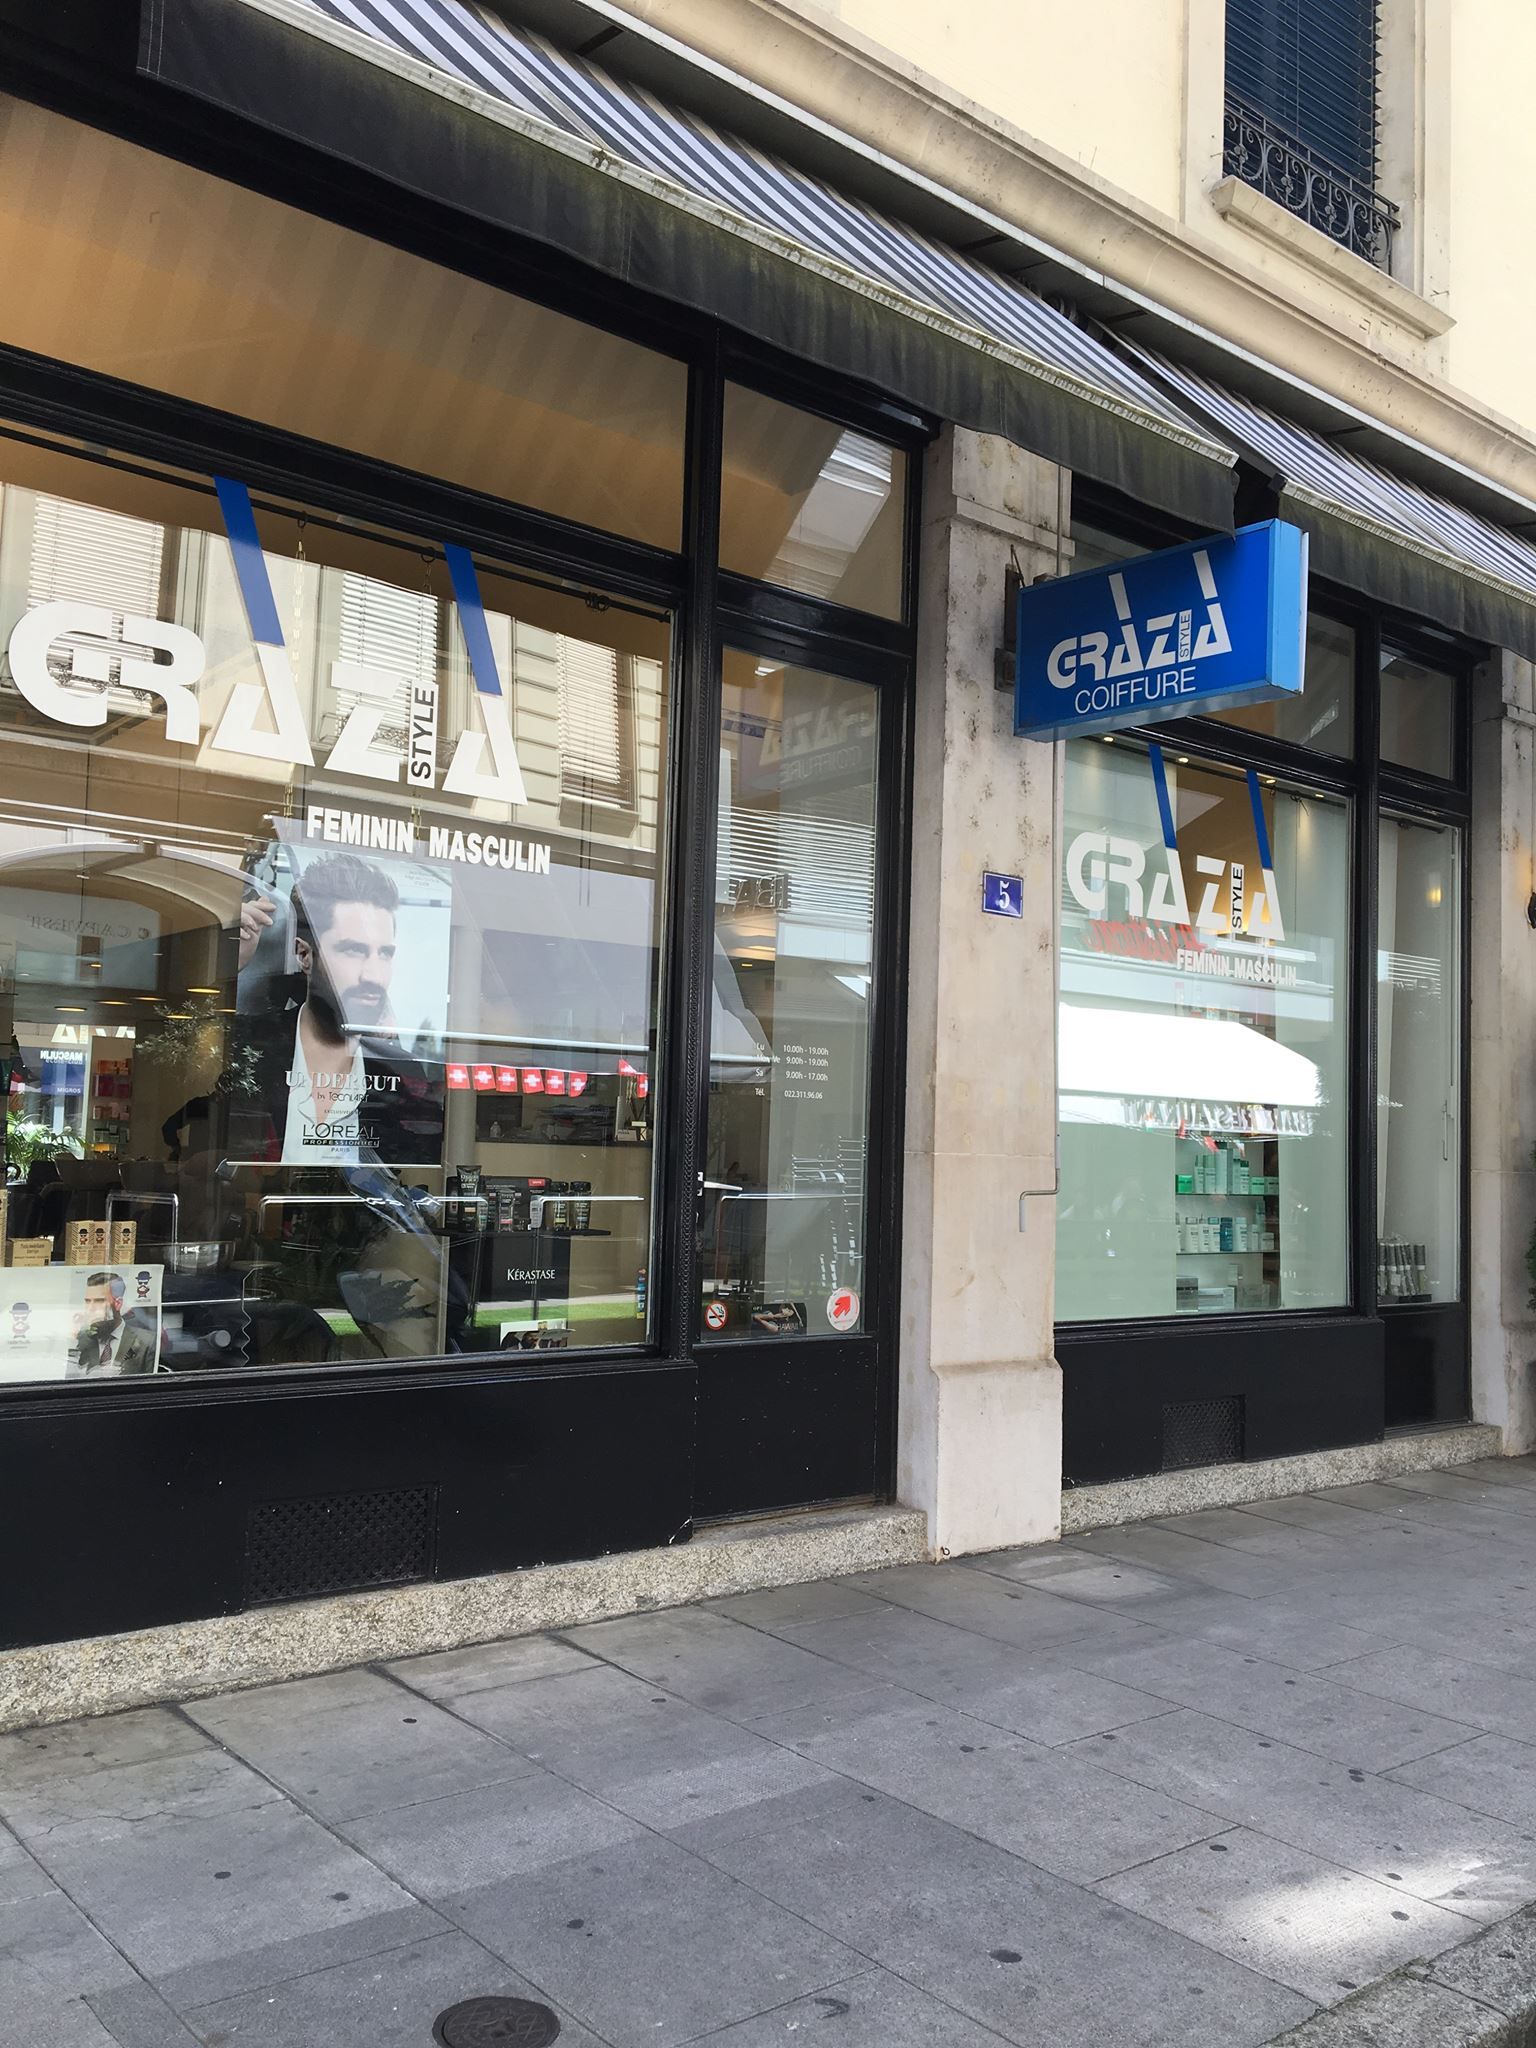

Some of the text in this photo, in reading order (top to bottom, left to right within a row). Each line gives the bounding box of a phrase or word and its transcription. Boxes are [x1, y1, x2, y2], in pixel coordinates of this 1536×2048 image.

[1180, 614, 1190, 657] STYLE
[1075, 666, 1196, 714] COIFFURE
[411, 686, 436, 780] STYLE
[307, 805, 550, 874] FEMININ MASCULIN
[995, 880, 1010, 909] 5
[1232, 866, 1243, 929] STYLE
[783, 1045, 803, 1054] 10.00h
[808, 1047, 829, 1056] 19.00h
[786, 1056, 803, 1065] 9.00h
[808, 1058, 829, 1067] 19.00h
[285, 1070, 401, 1092] UNDERCUT
[755, 1068, 764, 1077] Sa
[785, 1071, 803, 1079] 9.00h
[808, 1073, 829, 1081] 17.00h
[57, 1087, 81, 1095] MIGROS
[507, 1268, 556, 1281] KÉRASTASE
